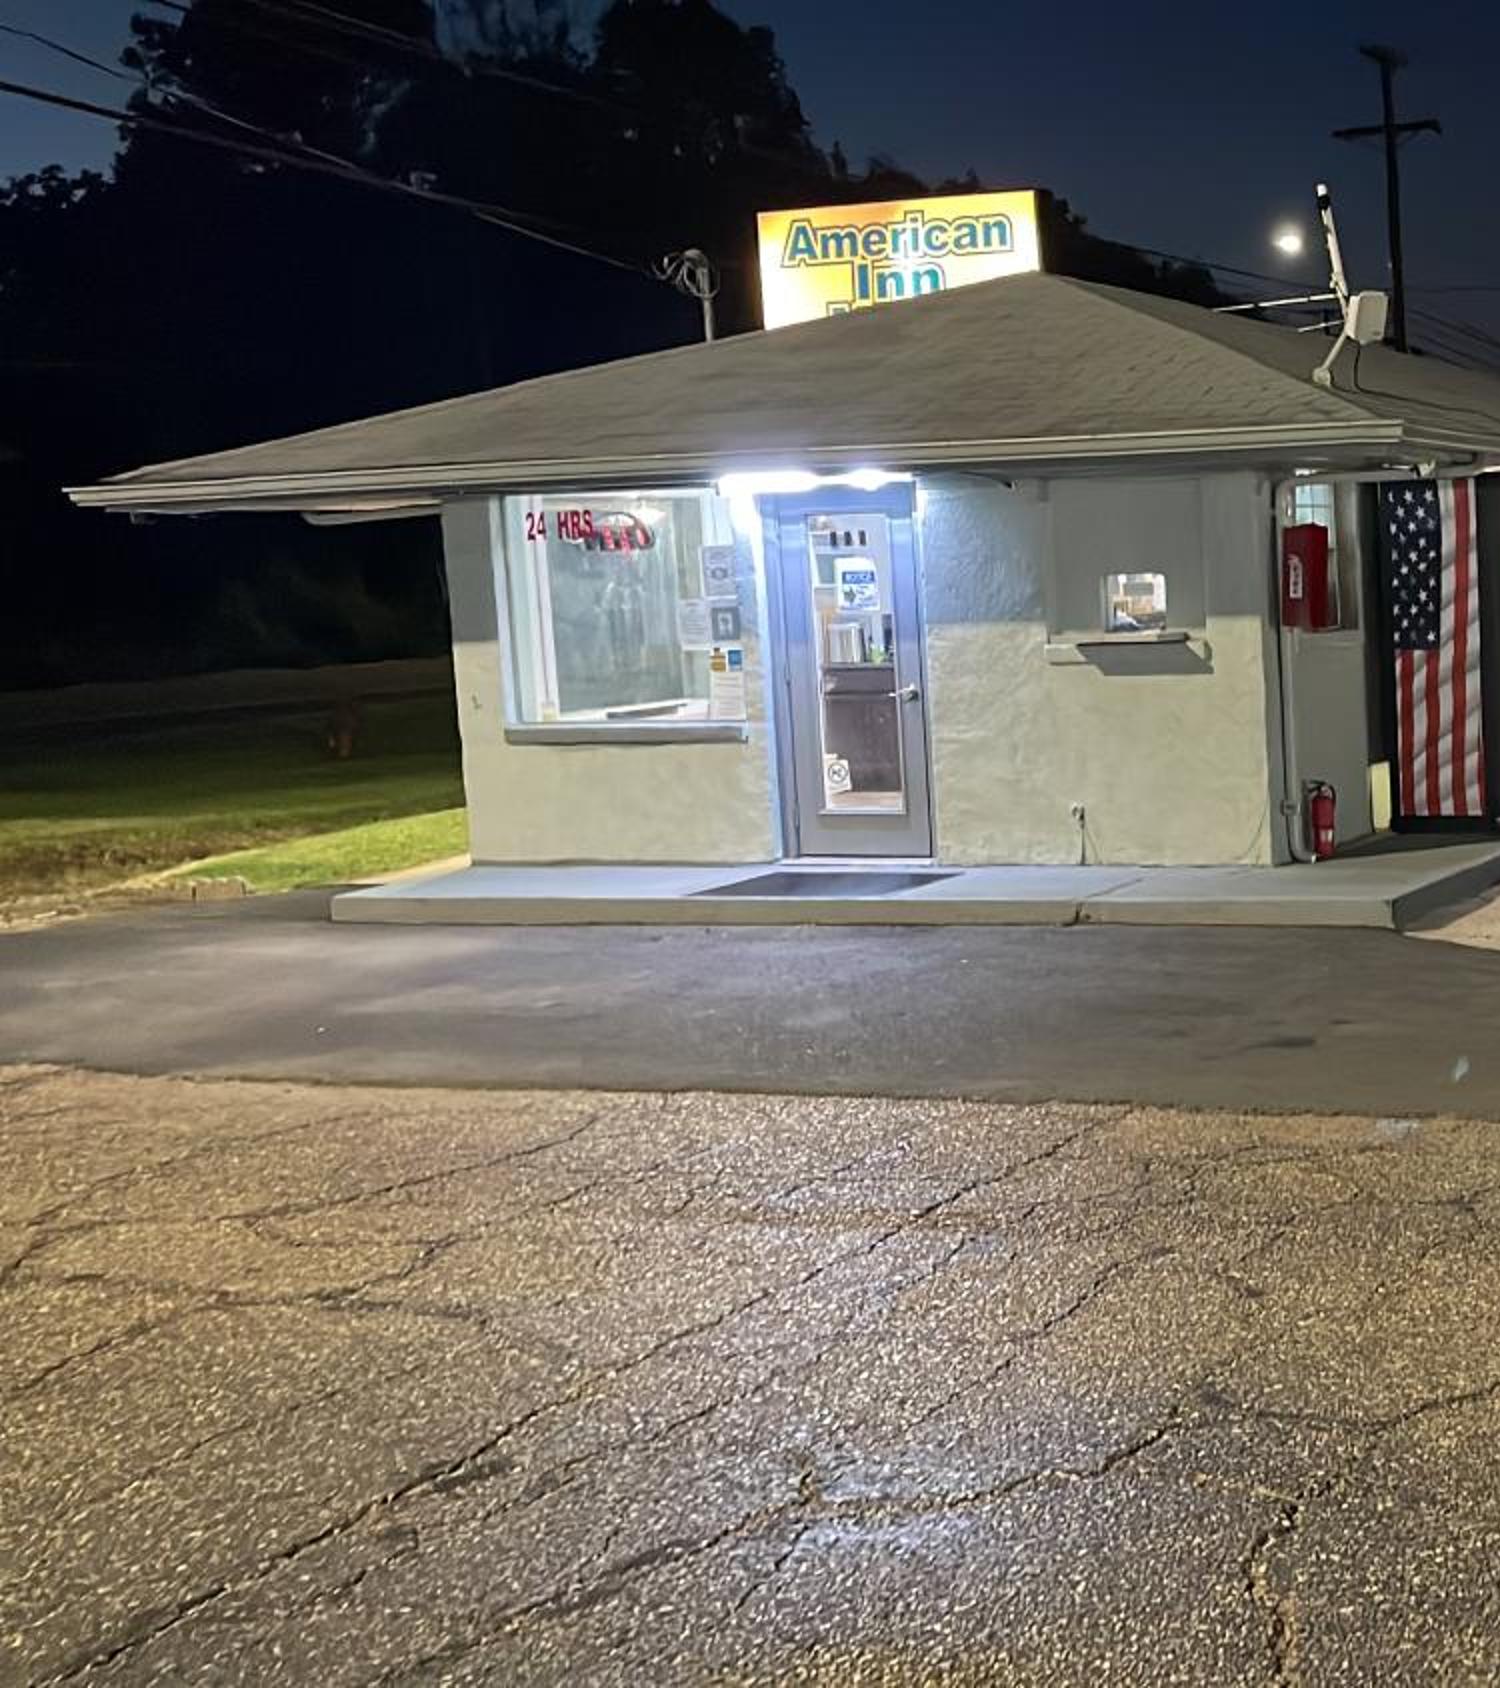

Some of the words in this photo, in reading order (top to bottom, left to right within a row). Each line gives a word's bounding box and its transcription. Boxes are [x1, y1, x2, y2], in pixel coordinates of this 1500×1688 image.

[786, 212, 1010, 262] American
[856, 262, 942, 301] Inn
[525, 511, 547, 541] 24
[556, 509, 593, 540] HRS
